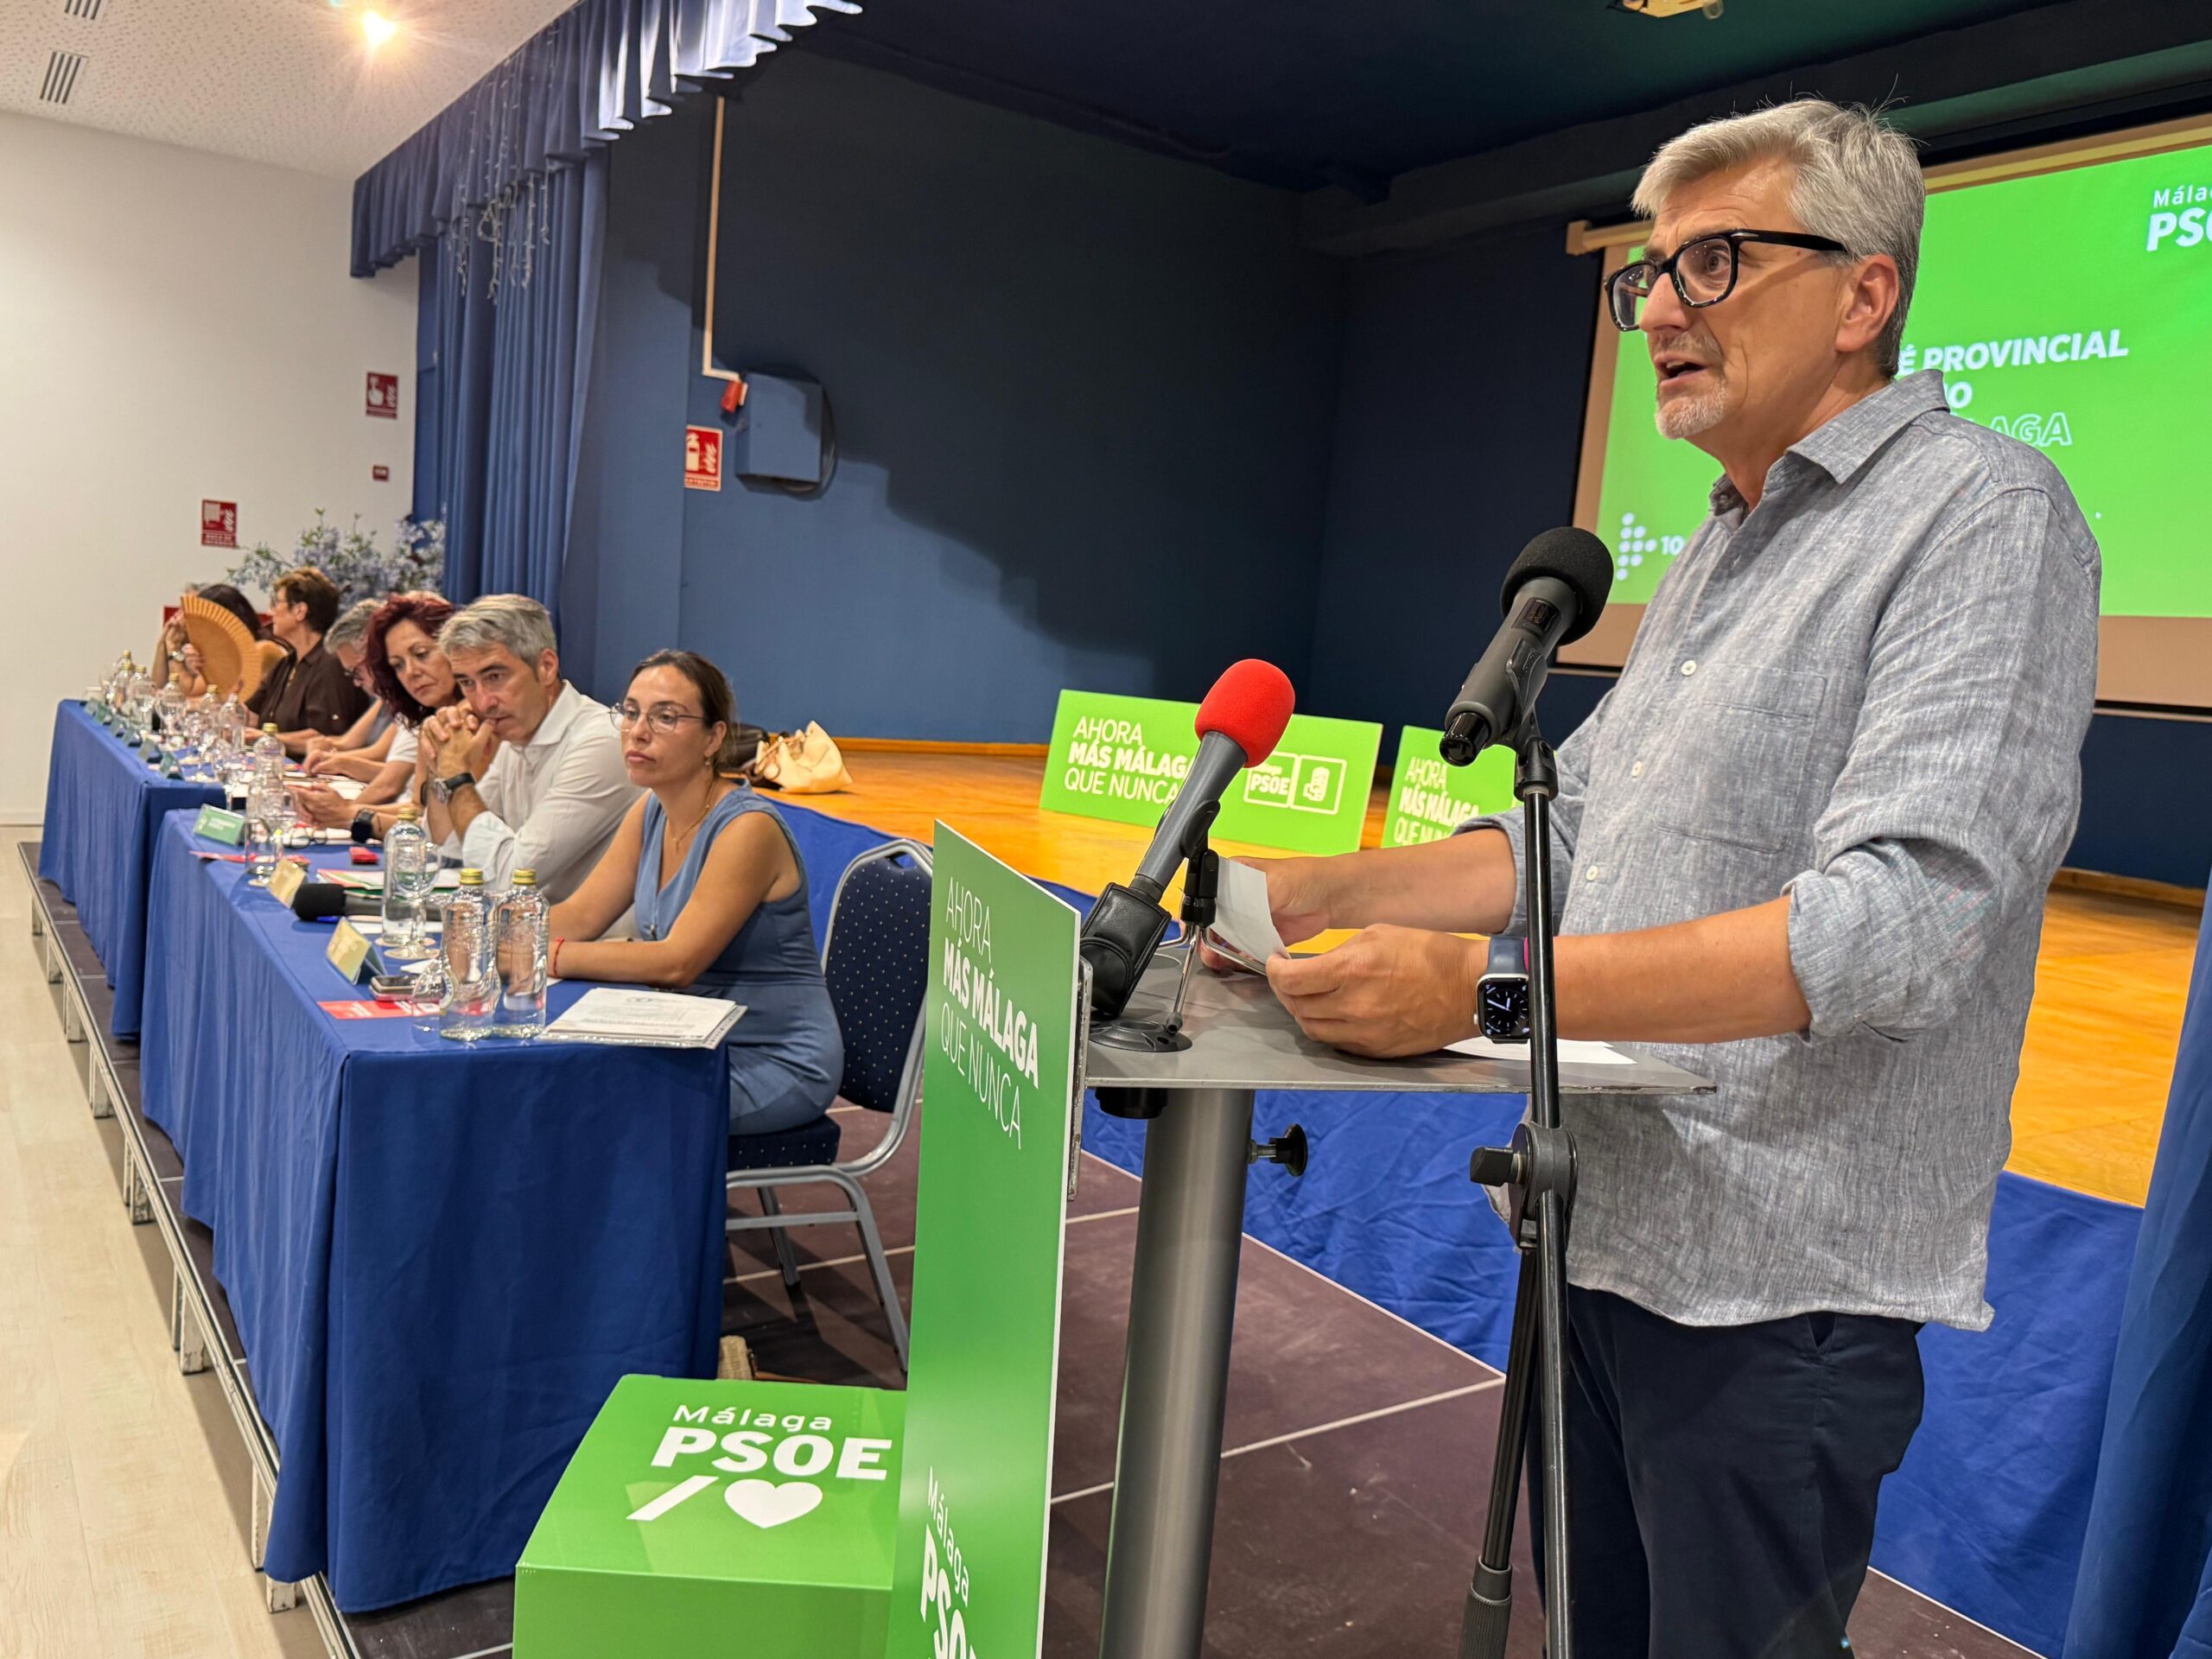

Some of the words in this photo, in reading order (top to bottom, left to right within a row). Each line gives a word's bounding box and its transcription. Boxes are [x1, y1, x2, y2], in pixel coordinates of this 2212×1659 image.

[2152, 184, 2212, 208] Mála
[1923, 328, 2130, 373] PROVINCIAL
[1072, 715, 1144, 746] AHORA
[1067, 739, 1113, 768] MÁS
[1064, 767, 1107, 795] QUE
[1249, 772, 1291, 796] PSOE
[1404, 756, 1448, 790] AHORA
[1398, 783, 1427, 818] MÁS
[1394, 816, 1421, 846] QUE
[945, 875, 992, 964] AHORA
[943, 936, 971, 1010] MÁS
[971, 967, 1039, 1090] MÁLAGA
[940, 1001, 968, 1077] QUE
[968, 1033, 1021, 1151] NUNCA
[672, 1404, 833, 1433] Málaga
[650, 1426, 893, 1481] PSOE
[927, 1465, 970, 1609] Málaga
[919, 1522, 979, 1659] PSO
